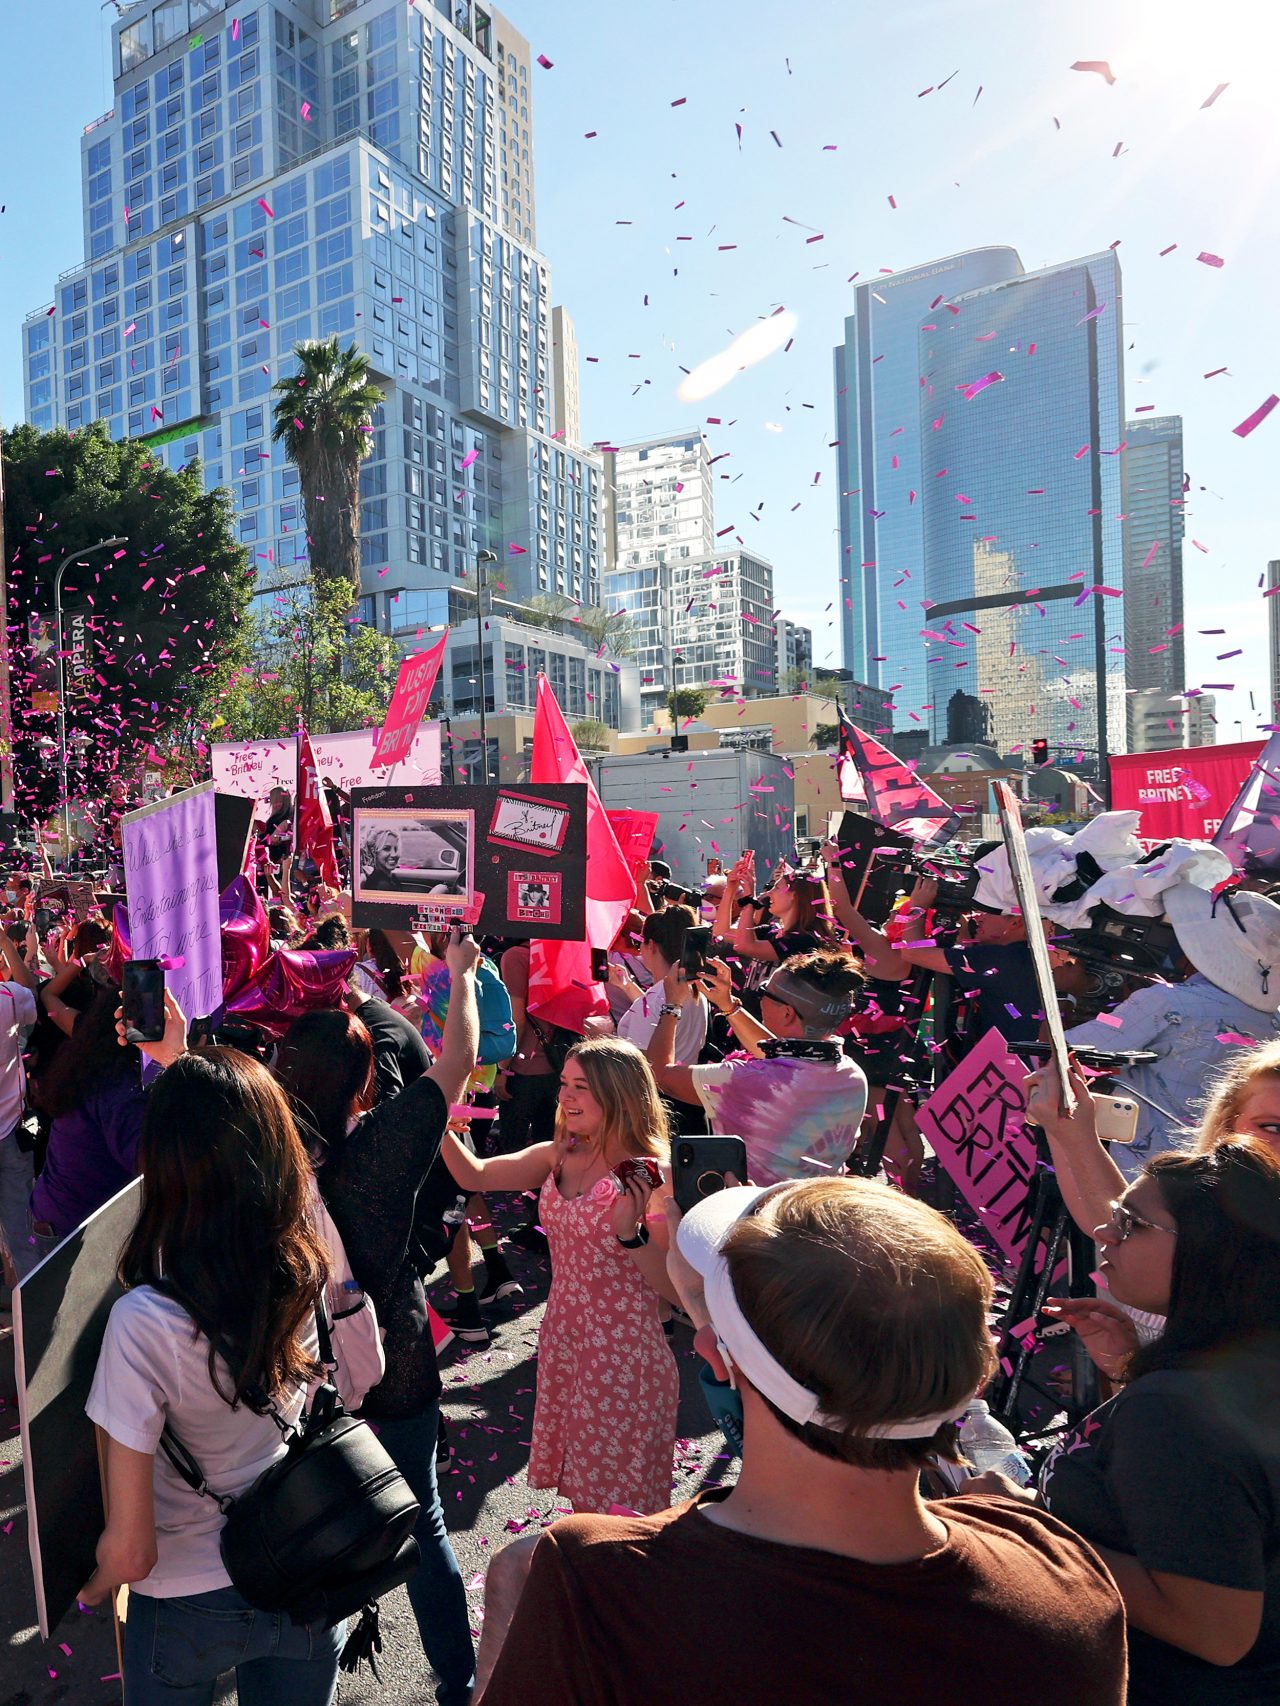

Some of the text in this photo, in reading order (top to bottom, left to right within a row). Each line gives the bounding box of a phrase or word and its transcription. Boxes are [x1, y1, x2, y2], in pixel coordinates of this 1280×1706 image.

[234, 752, 254, 764] Free
[230, 761, 263, 776] Britey
[340, 776, 362, 788] Free
[1204, 819, 1222, 835] FR
